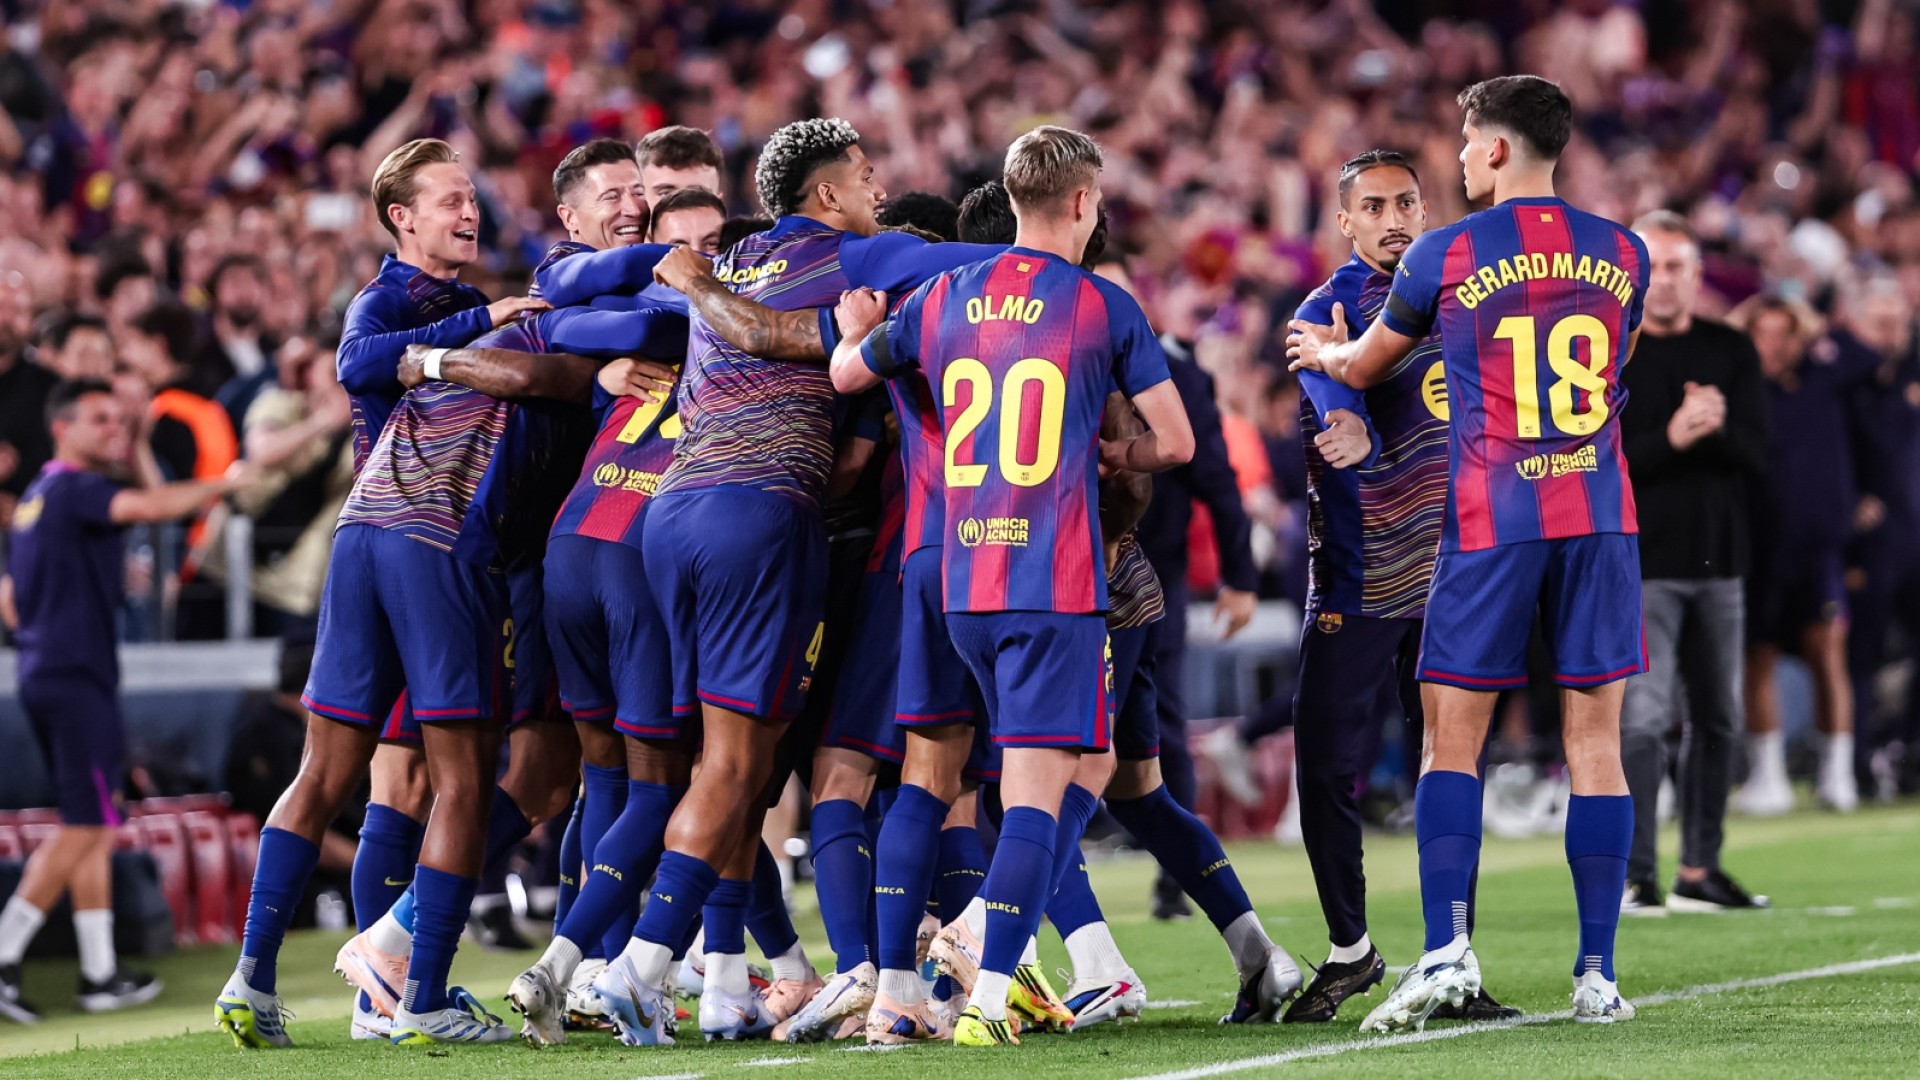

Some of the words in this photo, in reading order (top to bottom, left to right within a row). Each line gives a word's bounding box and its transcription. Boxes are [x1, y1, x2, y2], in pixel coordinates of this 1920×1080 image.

[1455, 252, 1549, 309] GERARD
[966, 294, 1045, 325] OLMO
[1492, 314, 1610, 438] 18
[942, 357, 1066, 487] 20
[1551, 444, 1596, 466] UNHCR
[1551, 455, 1598, 475] ACNUR
[622, 479, 657, 492] ACNU
[628, 468, 664, 482] UNHC
[986, 517, 1029, 530] UNHCR
[986, 529, 1028, 542] ACNUR
[805, 621, 825, 672] 4
